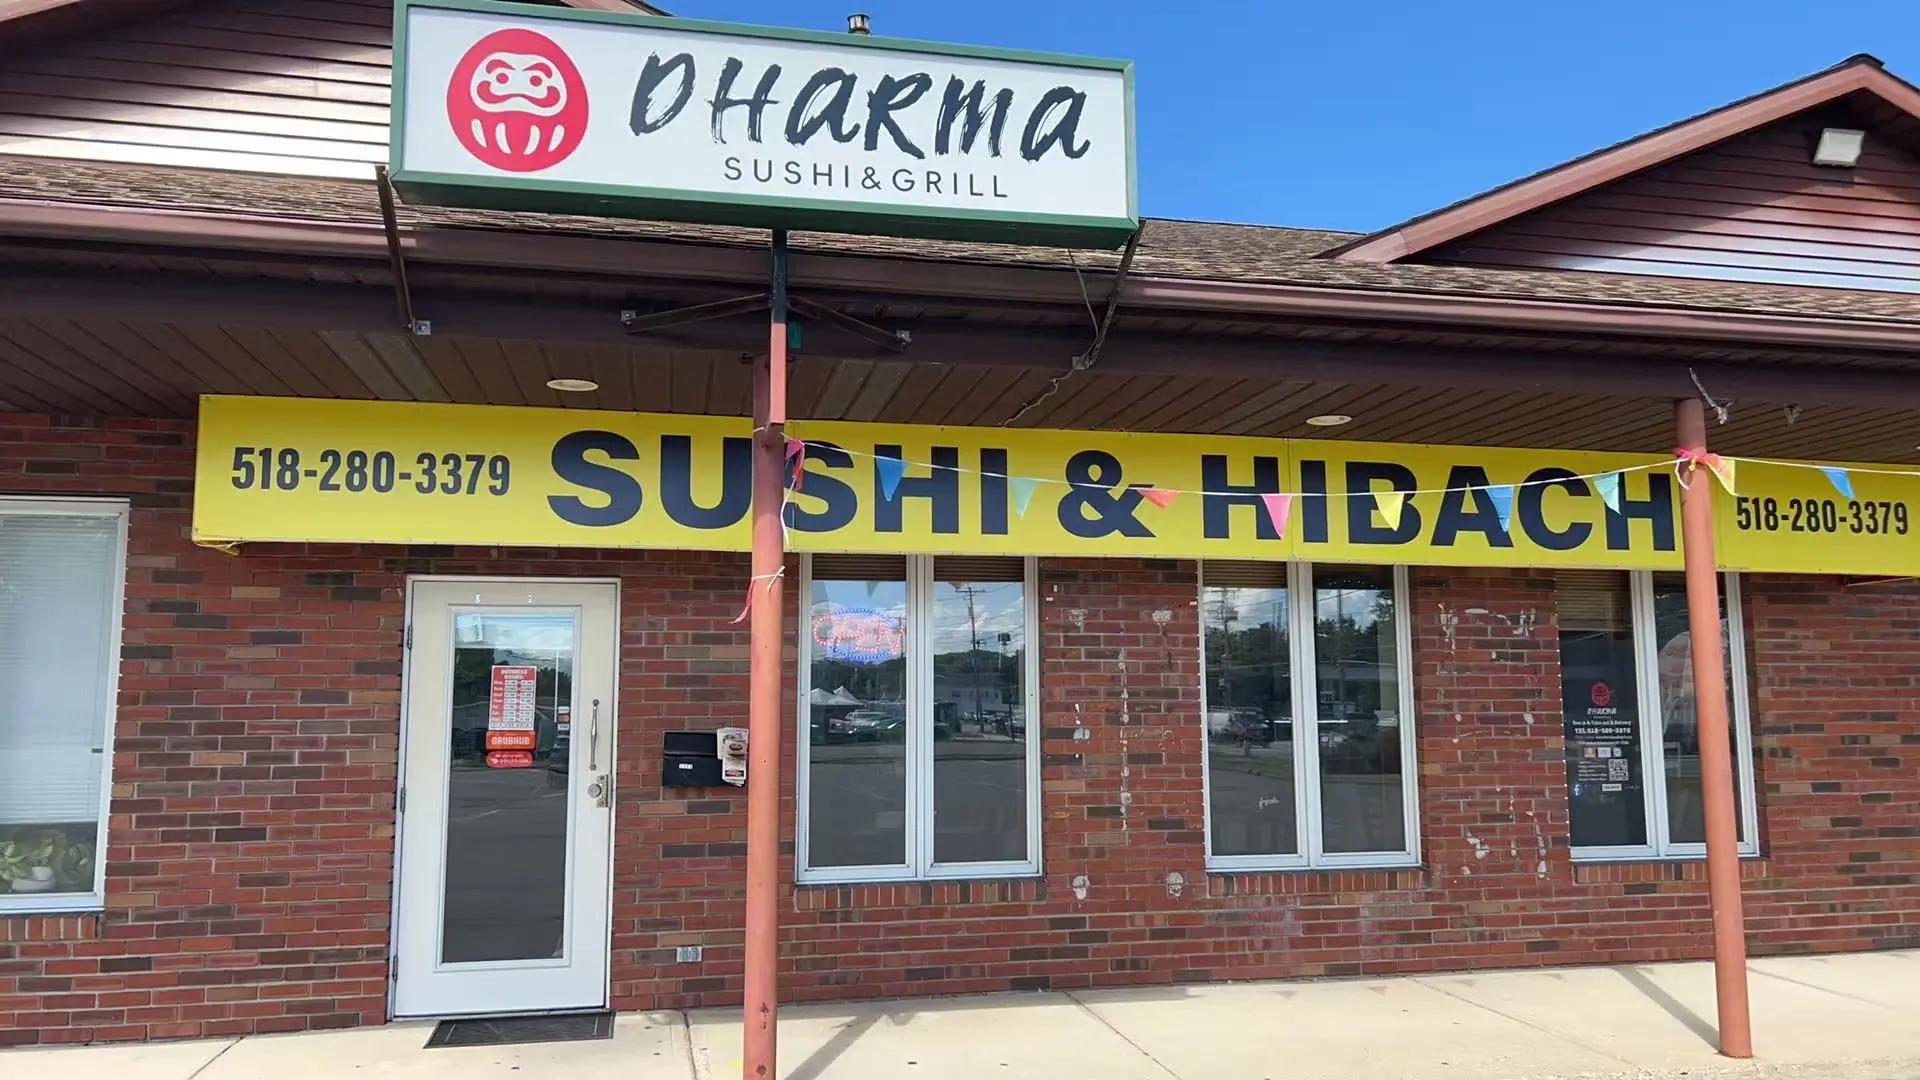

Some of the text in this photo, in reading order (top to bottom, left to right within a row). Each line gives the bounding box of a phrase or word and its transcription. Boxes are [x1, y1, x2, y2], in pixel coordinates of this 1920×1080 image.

[628, 50, 1091, 162] DHARMA
[723, 156, 1009, 198] SUSHI&GRILL
[231, 446, 511, 497] 518-280-3379
[547, 429, 1677, 552] SUSHI & HIBACH
[1736, 496, 1909, 535] 518-280-3379
[491, 736, 531, 746] GRUBHUB
